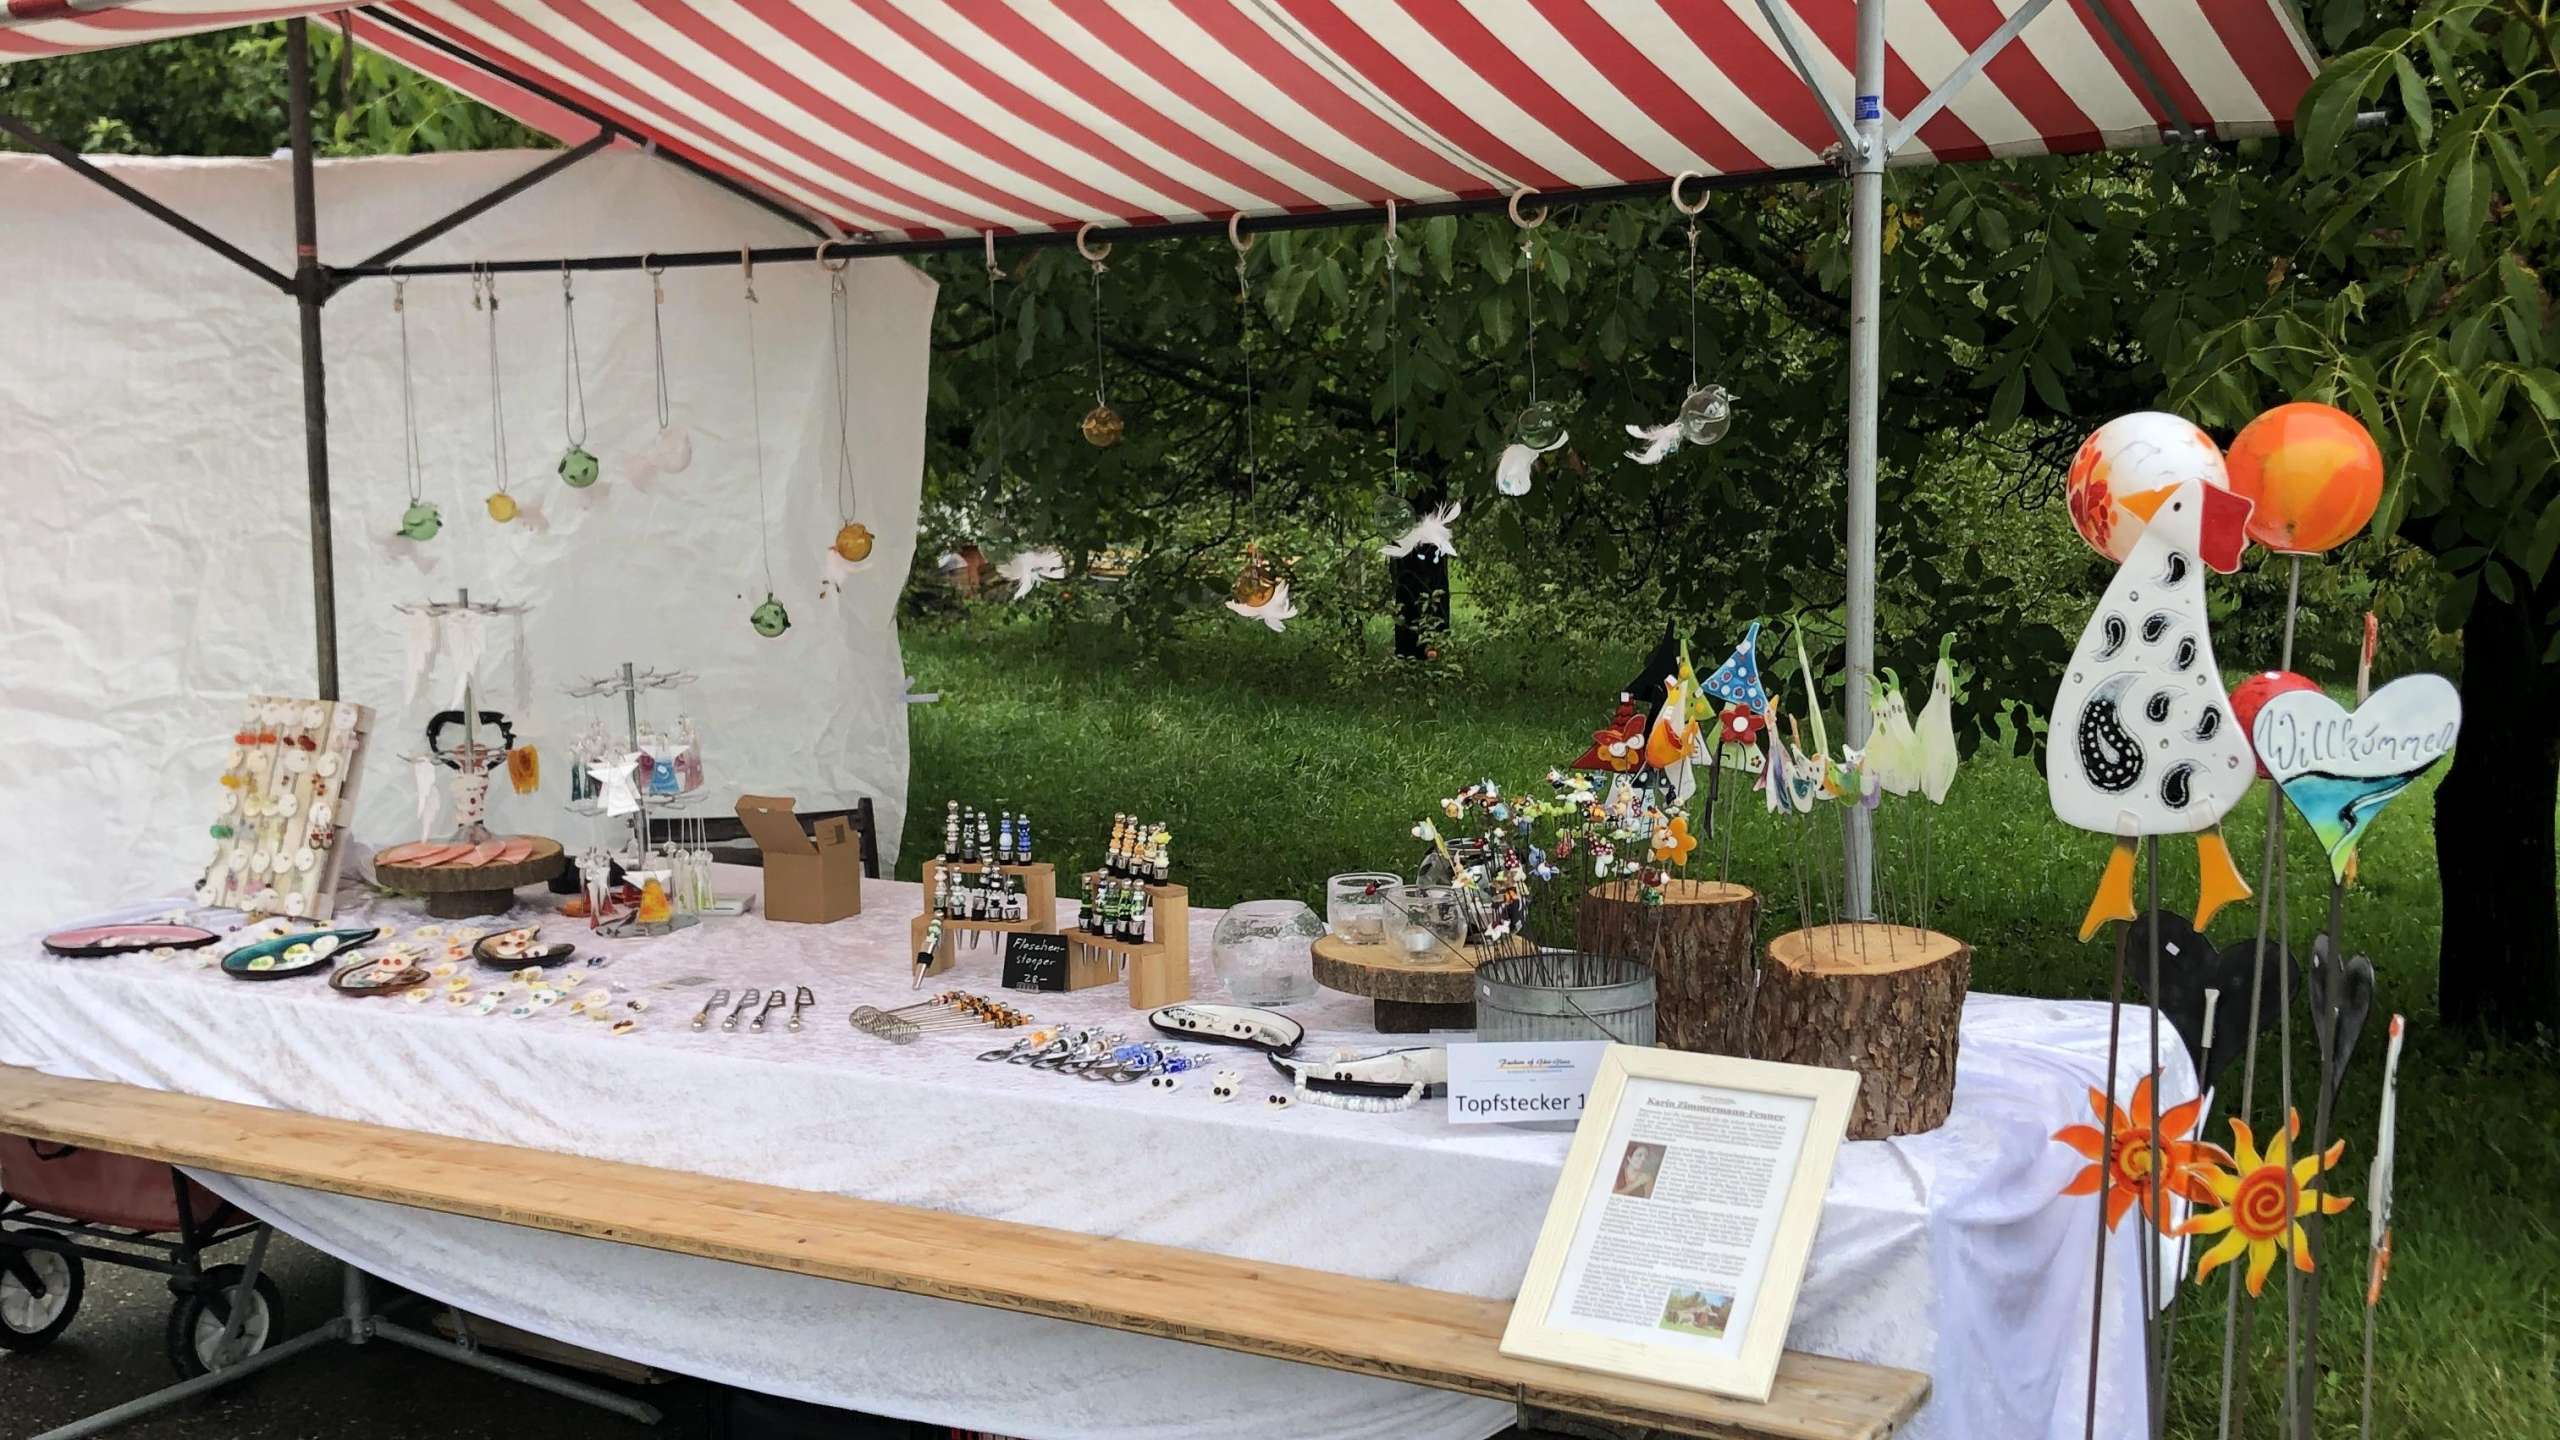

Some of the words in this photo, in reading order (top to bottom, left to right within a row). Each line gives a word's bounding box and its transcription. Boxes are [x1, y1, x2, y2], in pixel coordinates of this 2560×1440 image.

[1455, 1092, 1571, 1116] Topfstecker
[1646, 1096, 1676, 1109] Karin
[1677, 1099, 1787, 1123] Zimmermann-Fenner
